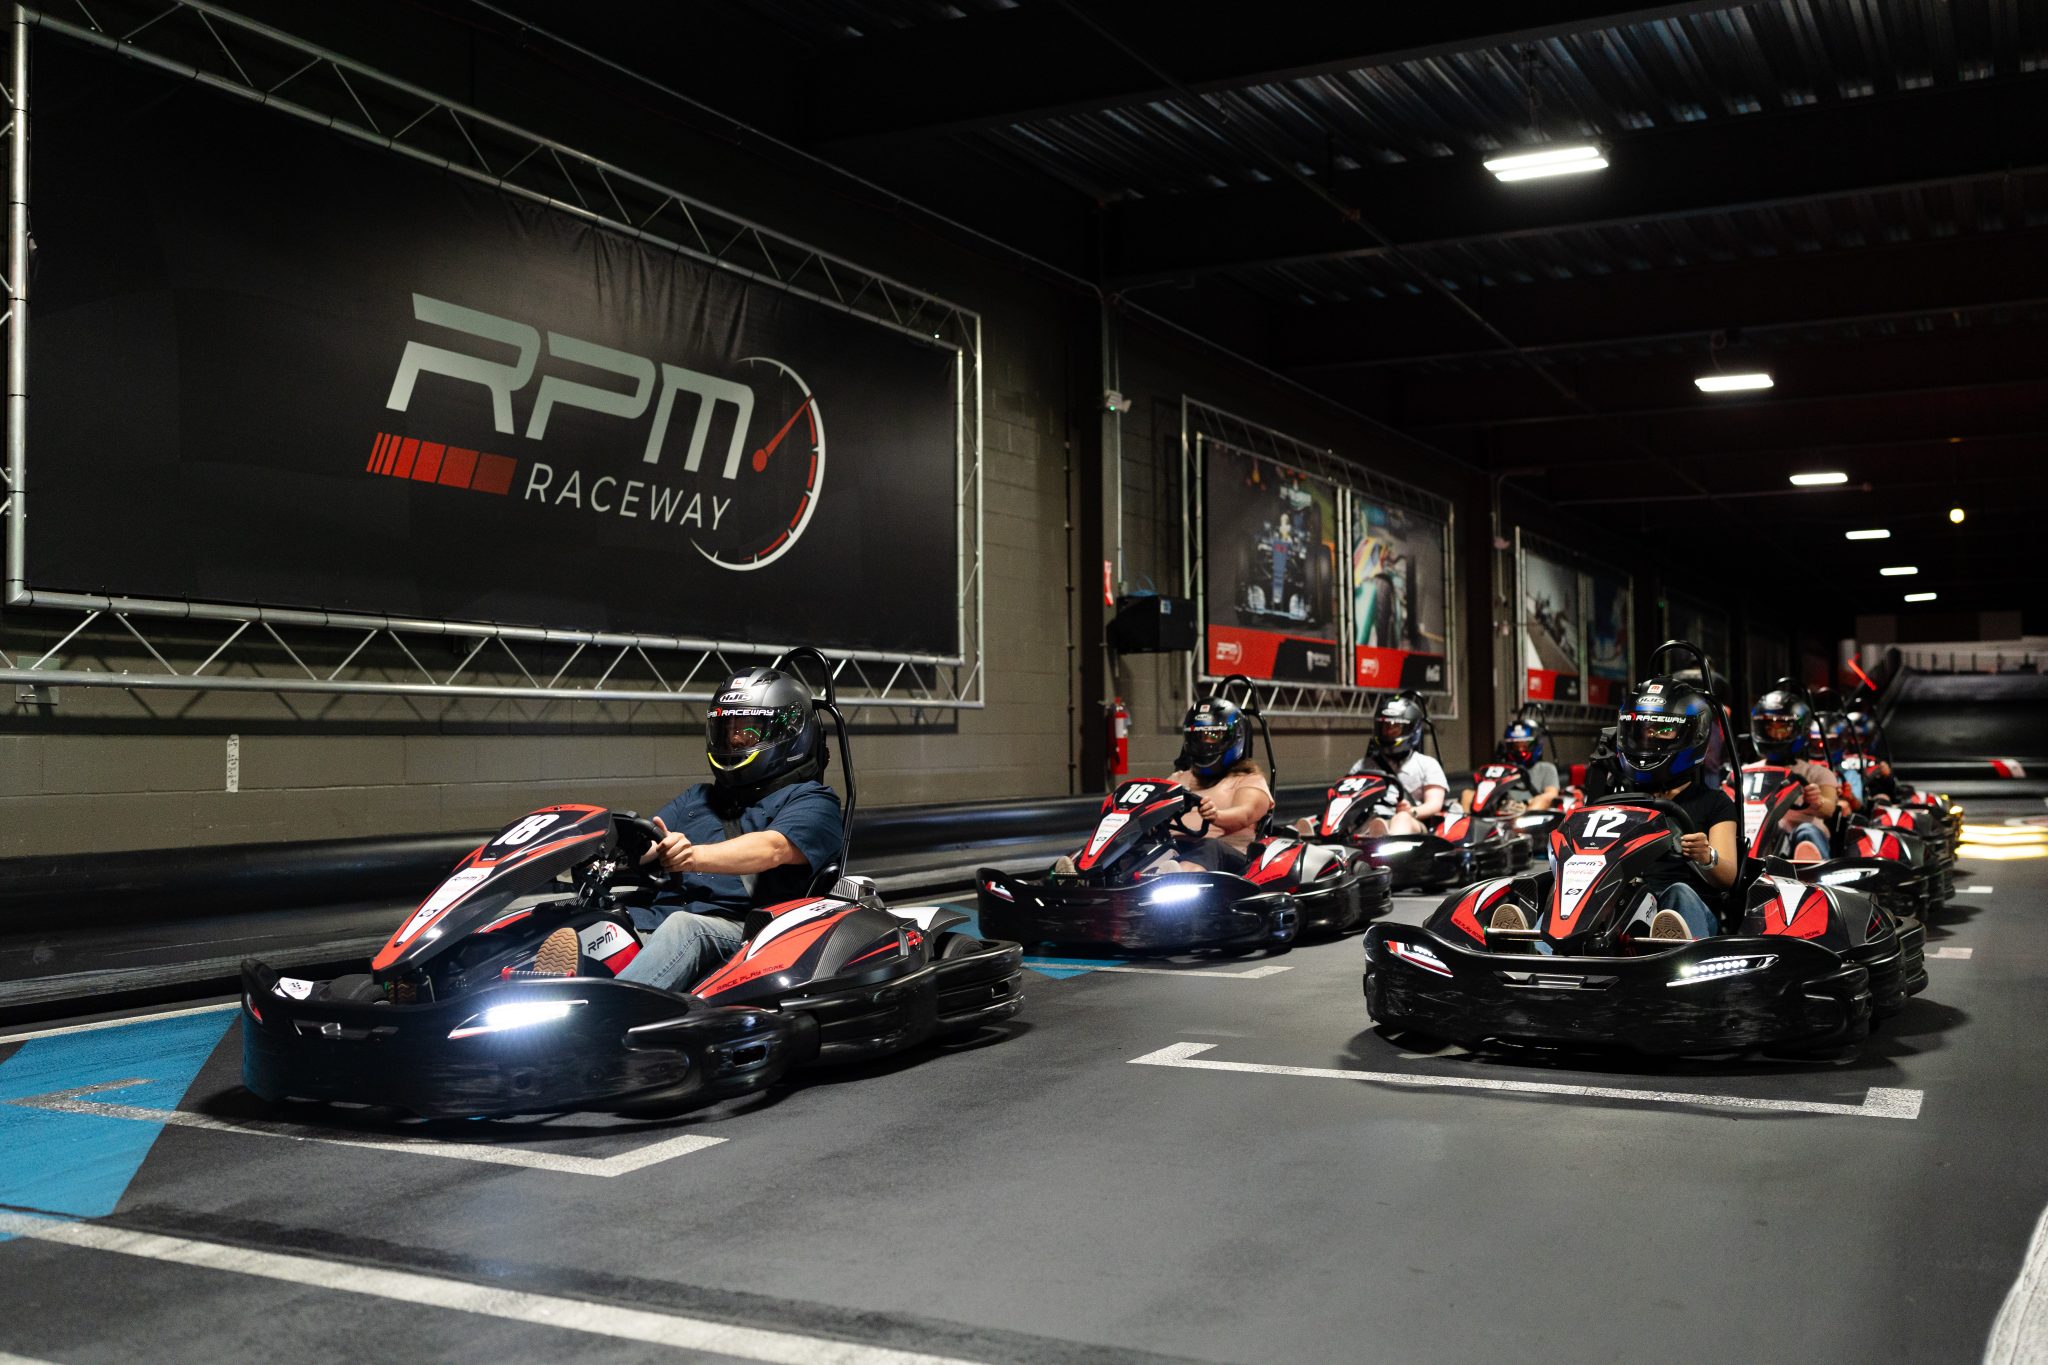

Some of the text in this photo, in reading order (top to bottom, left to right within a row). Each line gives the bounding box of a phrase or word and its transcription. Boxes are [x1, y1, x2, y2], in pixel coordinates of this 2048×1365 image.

[386, 293, 755, 480] RPM
[524, 462, 731, 531] RACEWAY
[721, 709, 775, 717] RACEWAY
[1635, 714, 1687, 724] RACEWAY
[1119, 783, 1156, 804] 16
[1338, 777, 1367, 791] 24
[491, 814, 560, 846] 18
[1581, 811, 1628, 838] 12
[587, 931, 614, 955] RPM
[716, 979, 738, 992] RACE
[739, 970, 762, 982] PLAY
